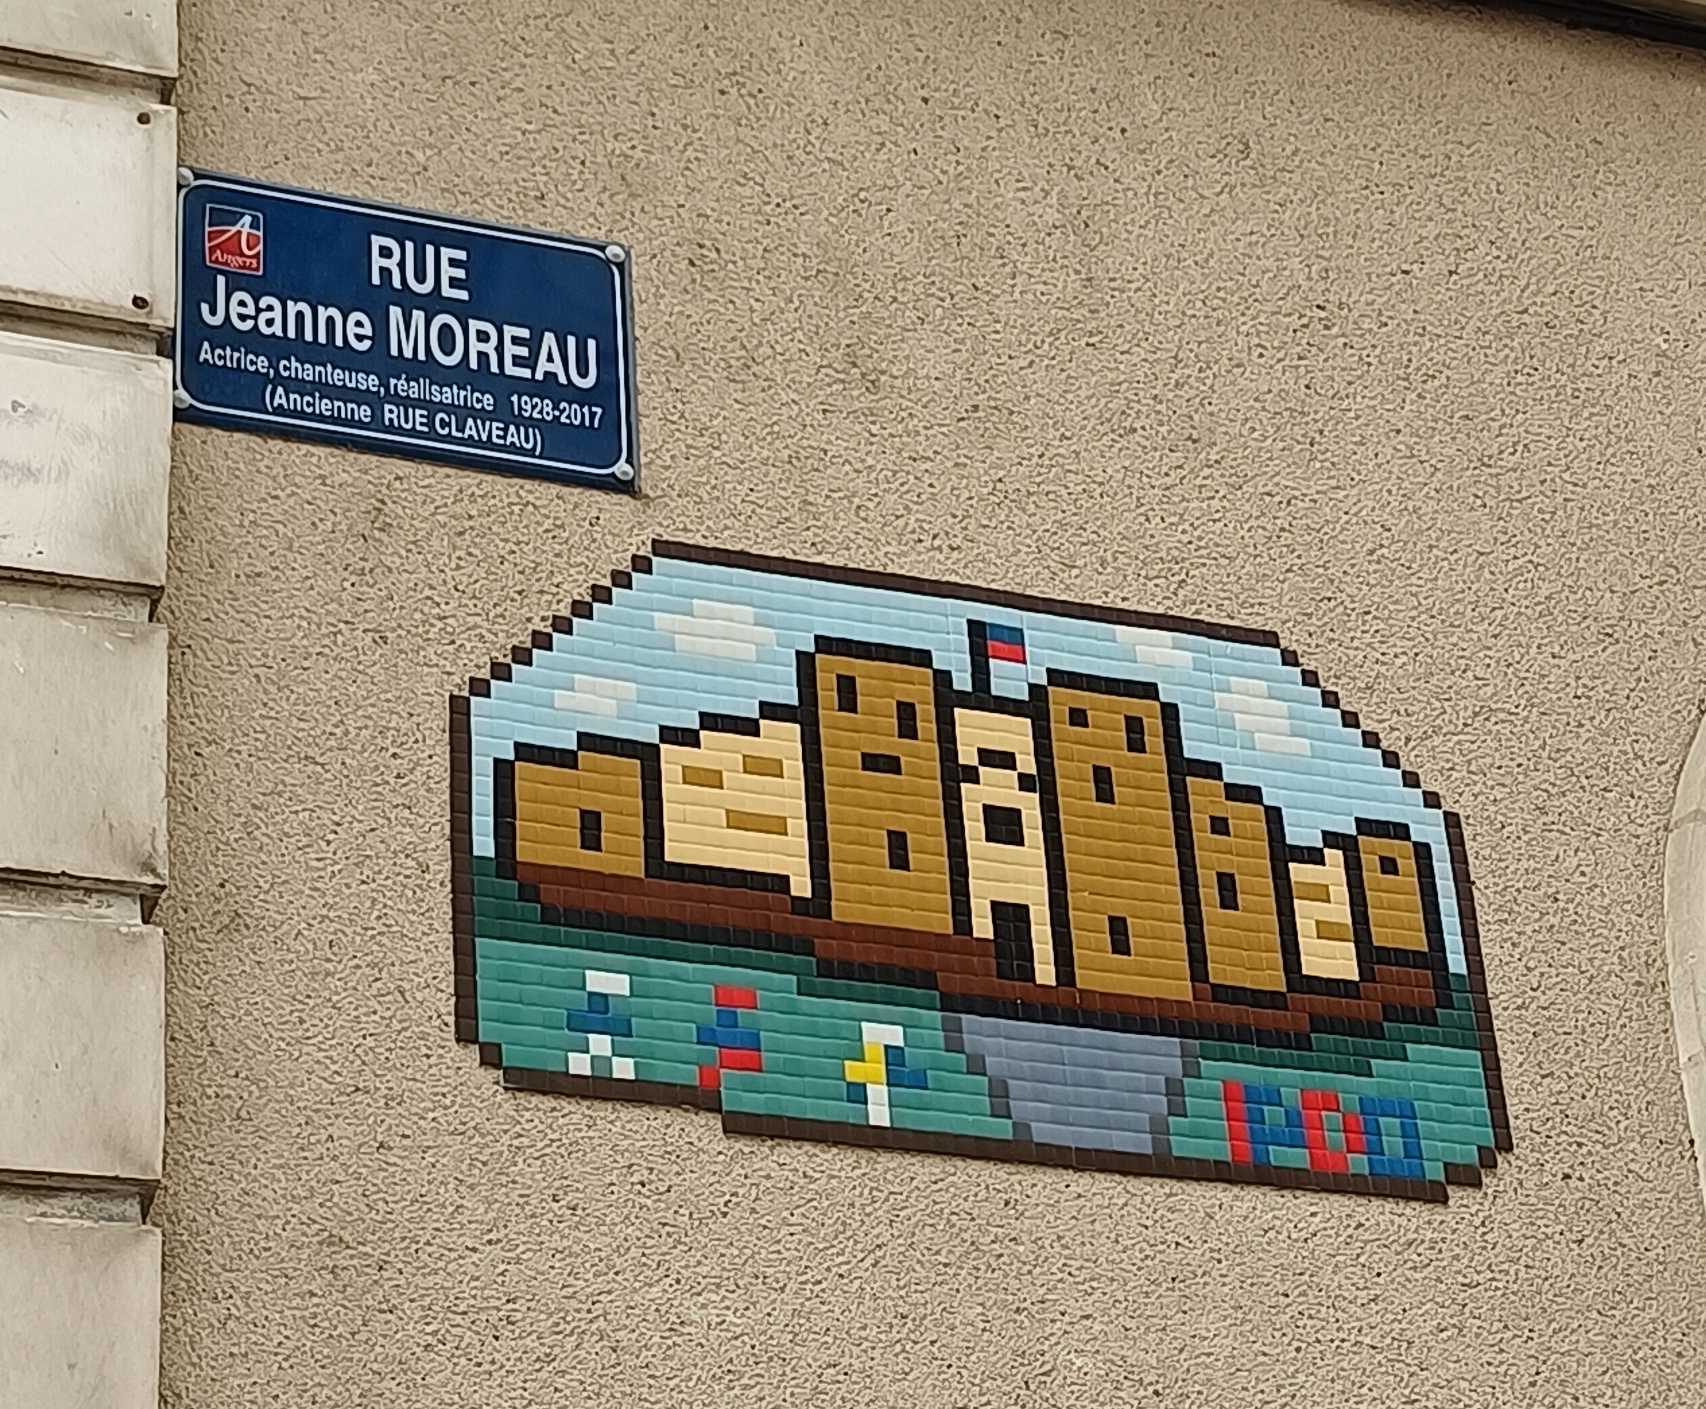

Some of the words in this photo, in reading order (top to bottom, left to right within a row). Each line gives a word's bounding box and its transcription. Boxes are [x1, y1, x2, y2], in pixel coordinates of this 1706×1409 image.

[211, 248, 258, 268] Angers
[370, 234, 470, 301] RUE
[200, 274, 373, 351] Jeanne
[389, 305, 598, 389] MOREAU
[199, 340, 274, 379] Actrice,
[278, 355, 385, 398] chanteuse,
[389, 373, 494, 411] réalisatrice
[510, 393, 603, 428] 1928-2017
[264, 384, 372, 423] (Ancienne
[383, 404, 430, 432] RUE
[434, 412, 542, 455] CLAVEAU)
